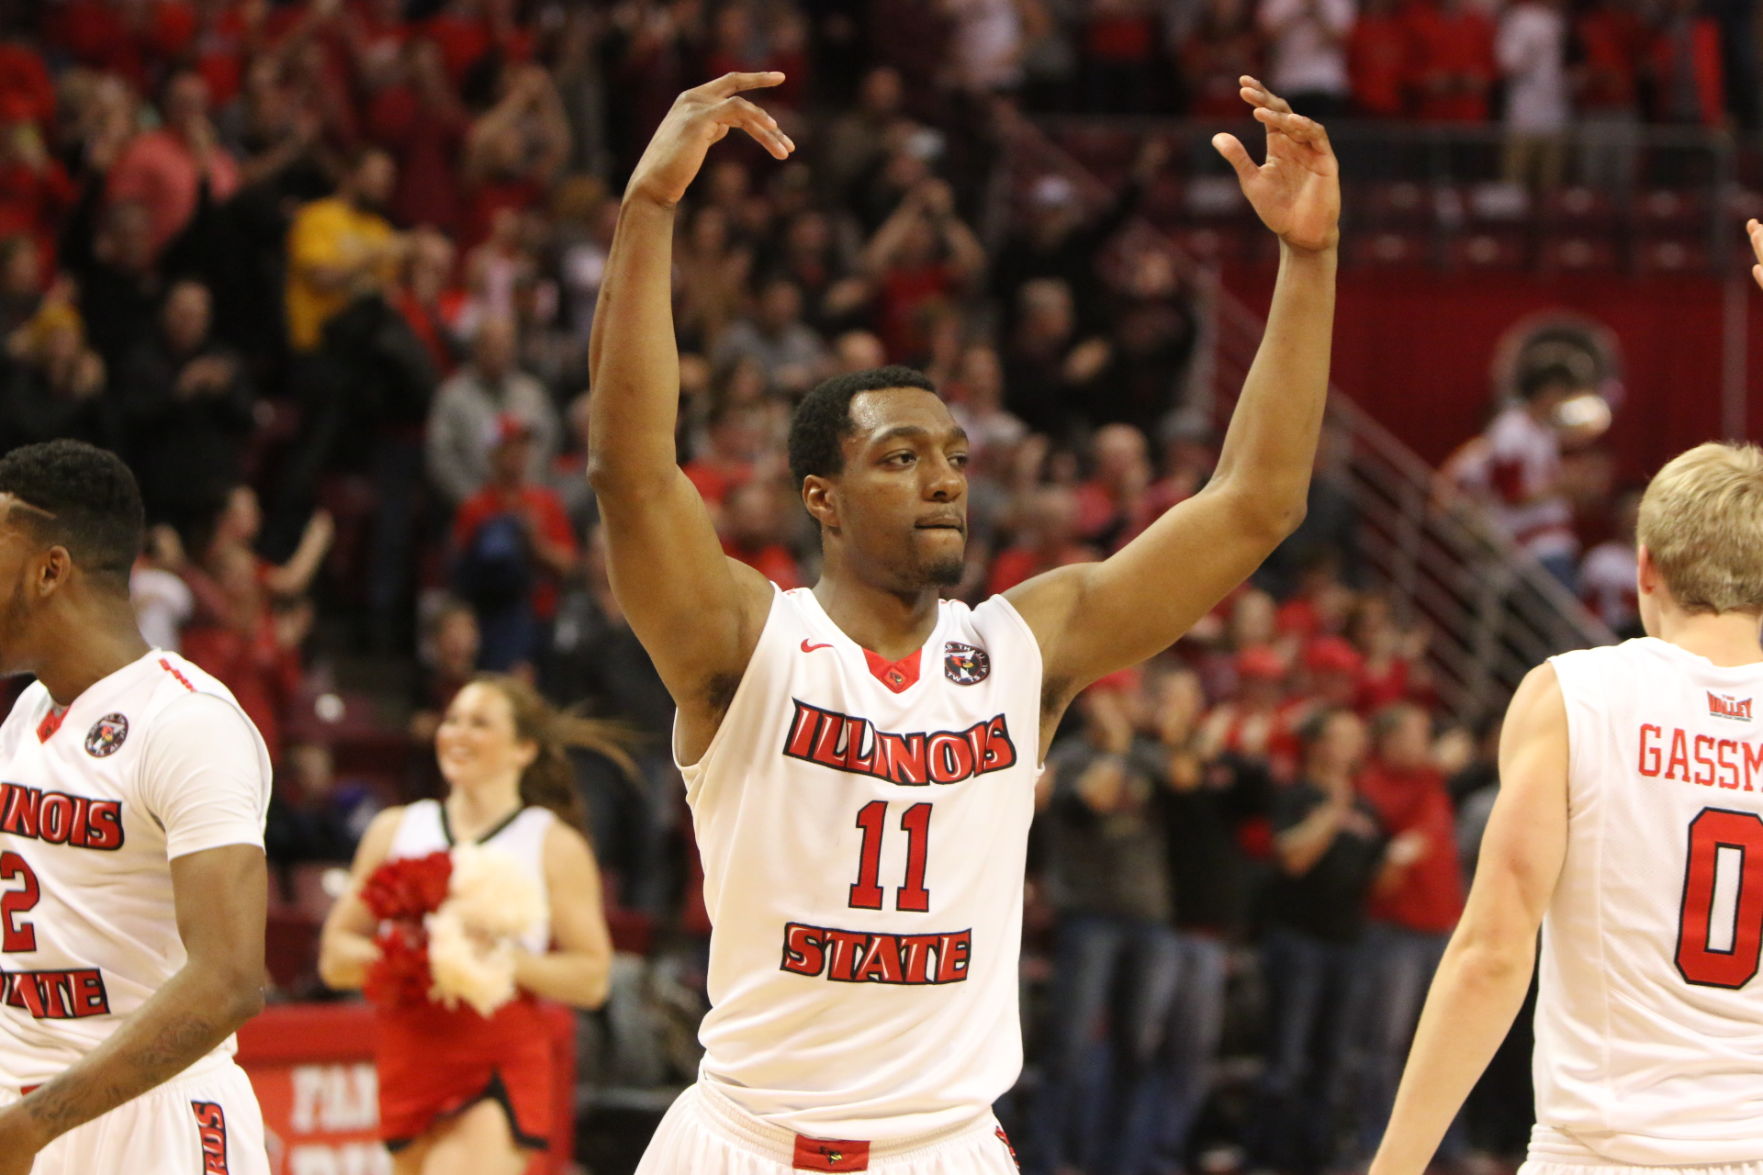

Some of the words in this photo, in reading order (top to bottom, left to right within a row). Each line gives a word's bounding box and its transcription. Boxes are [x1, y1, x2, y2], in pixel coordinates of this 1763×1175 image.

[783, 697, 1017, 786] ILLINOIS
[0, 850, 40, 952] 2
[848, 800, 933, 912] 11
[1674, 806, 1763, 990] 0
[0, 967, 111, 1019] ATE
[780, 922, 972, 984] STATE
